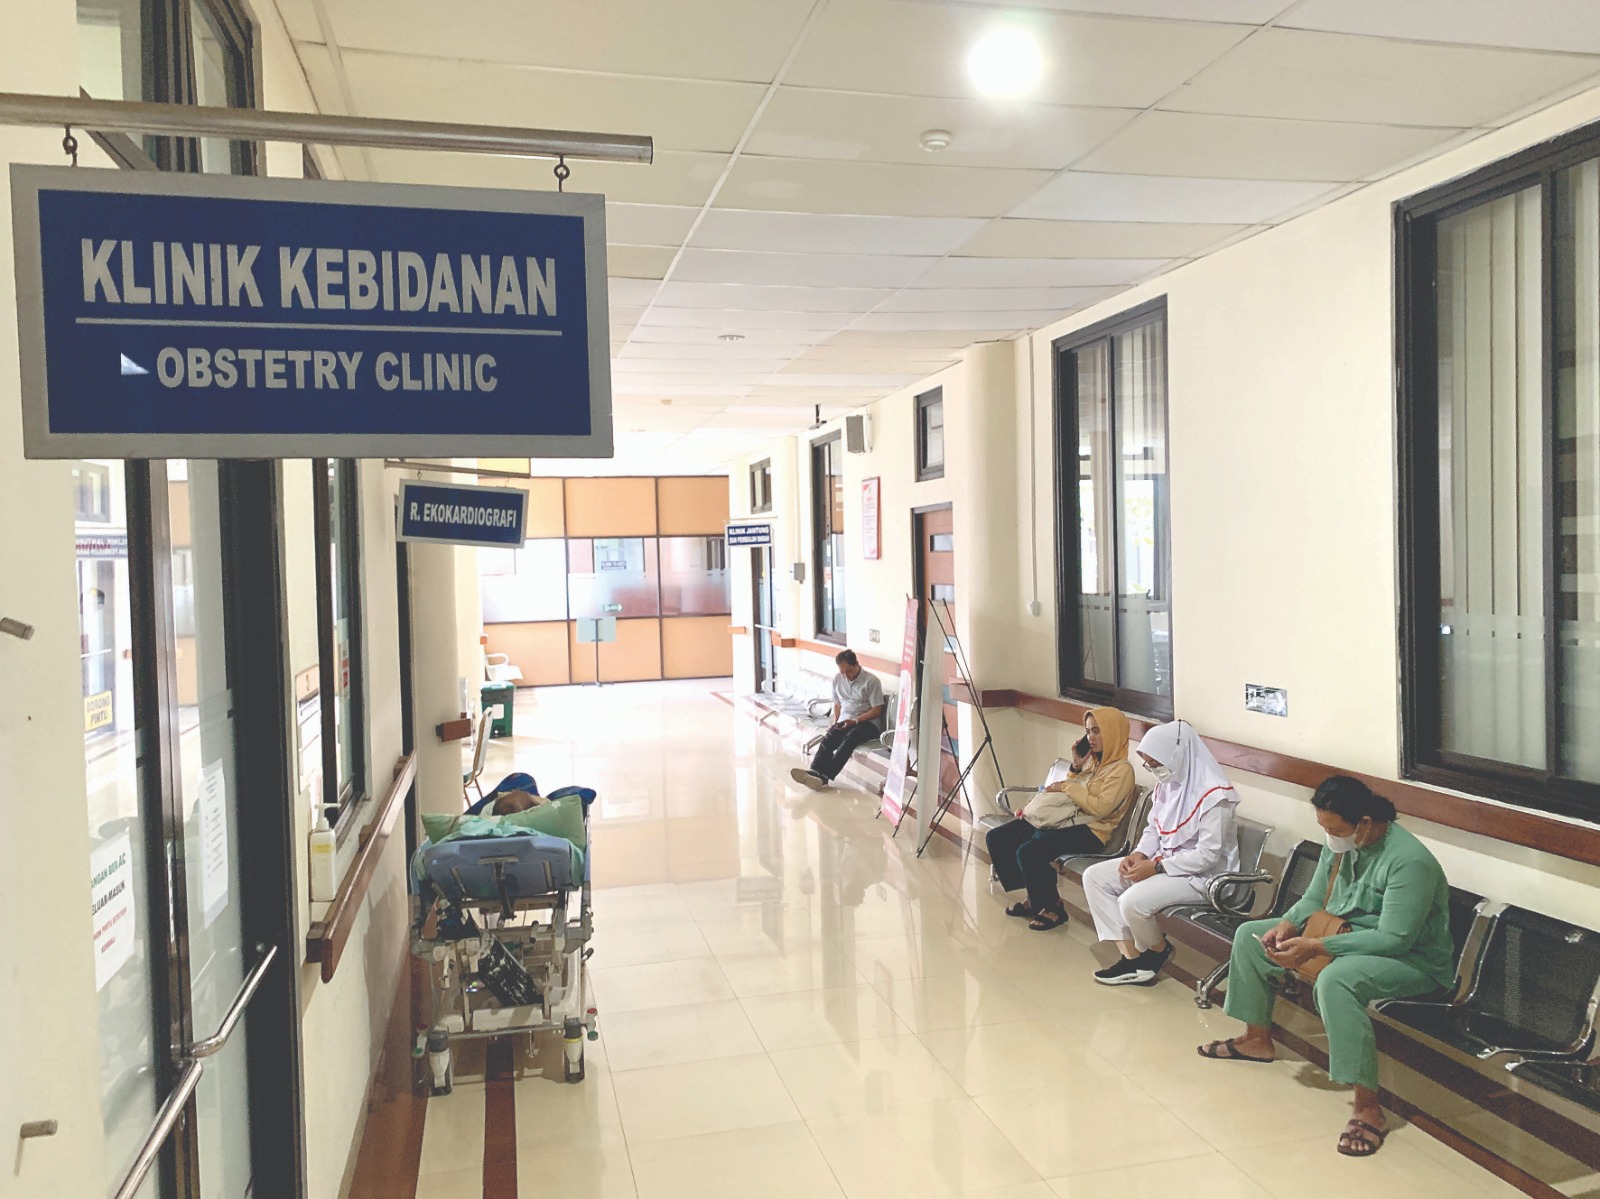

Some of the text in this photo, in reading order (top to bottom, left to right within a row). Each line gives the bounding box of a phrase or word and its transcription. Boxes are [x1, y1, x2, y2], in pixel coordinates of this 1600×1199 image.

[81, 238, 557, 316] KLINIK KEBIDANAN
[157, 348, 498, 392] OBSTETRY CLINIC
[410, 501, 517, 528] R. EKOKARDIOGRAFI
[90, 709, 108, 726] PINTU
